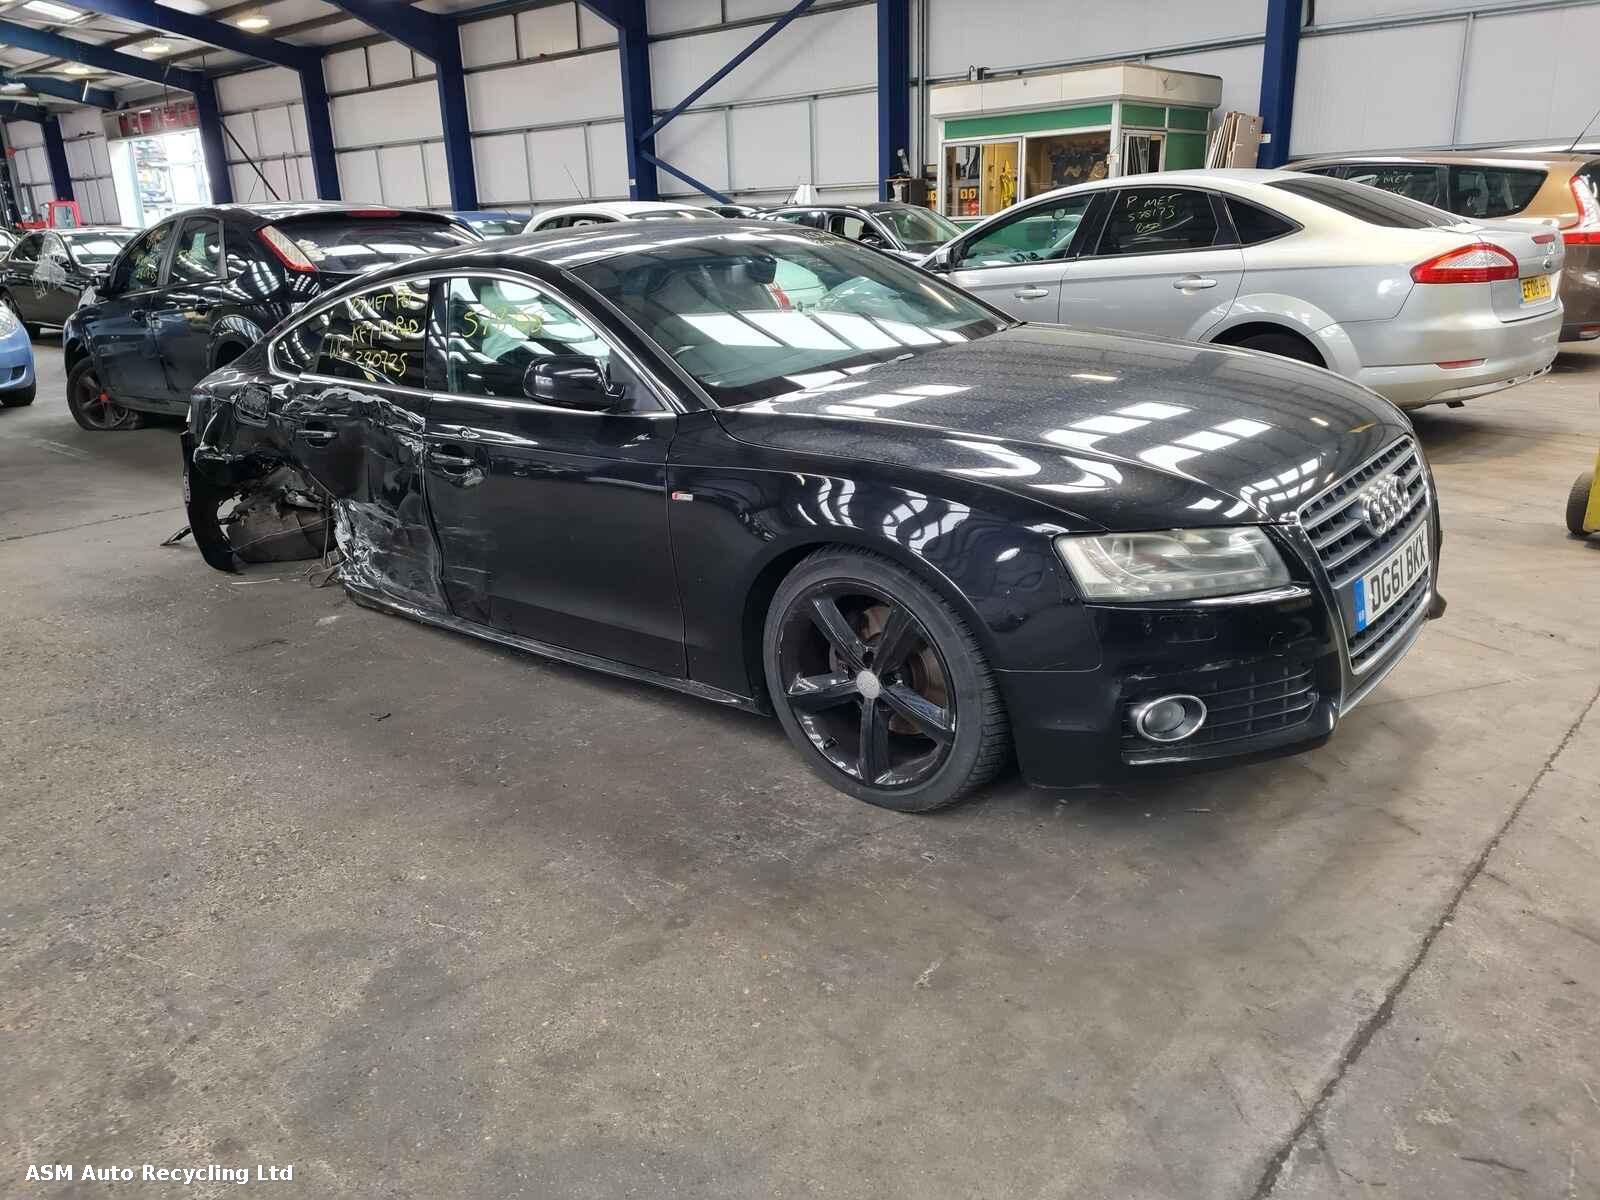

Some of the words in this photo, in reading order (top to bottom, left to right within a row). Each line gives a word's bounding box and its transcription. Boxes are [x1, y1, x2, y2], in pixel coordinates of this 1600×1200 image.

[1127, 195, 1138, 208] P
[1144, 193, 1183, 208] MET
[1371, 554, 1404, 613] DG61
[1406, 530, 1426, 581] BKX
